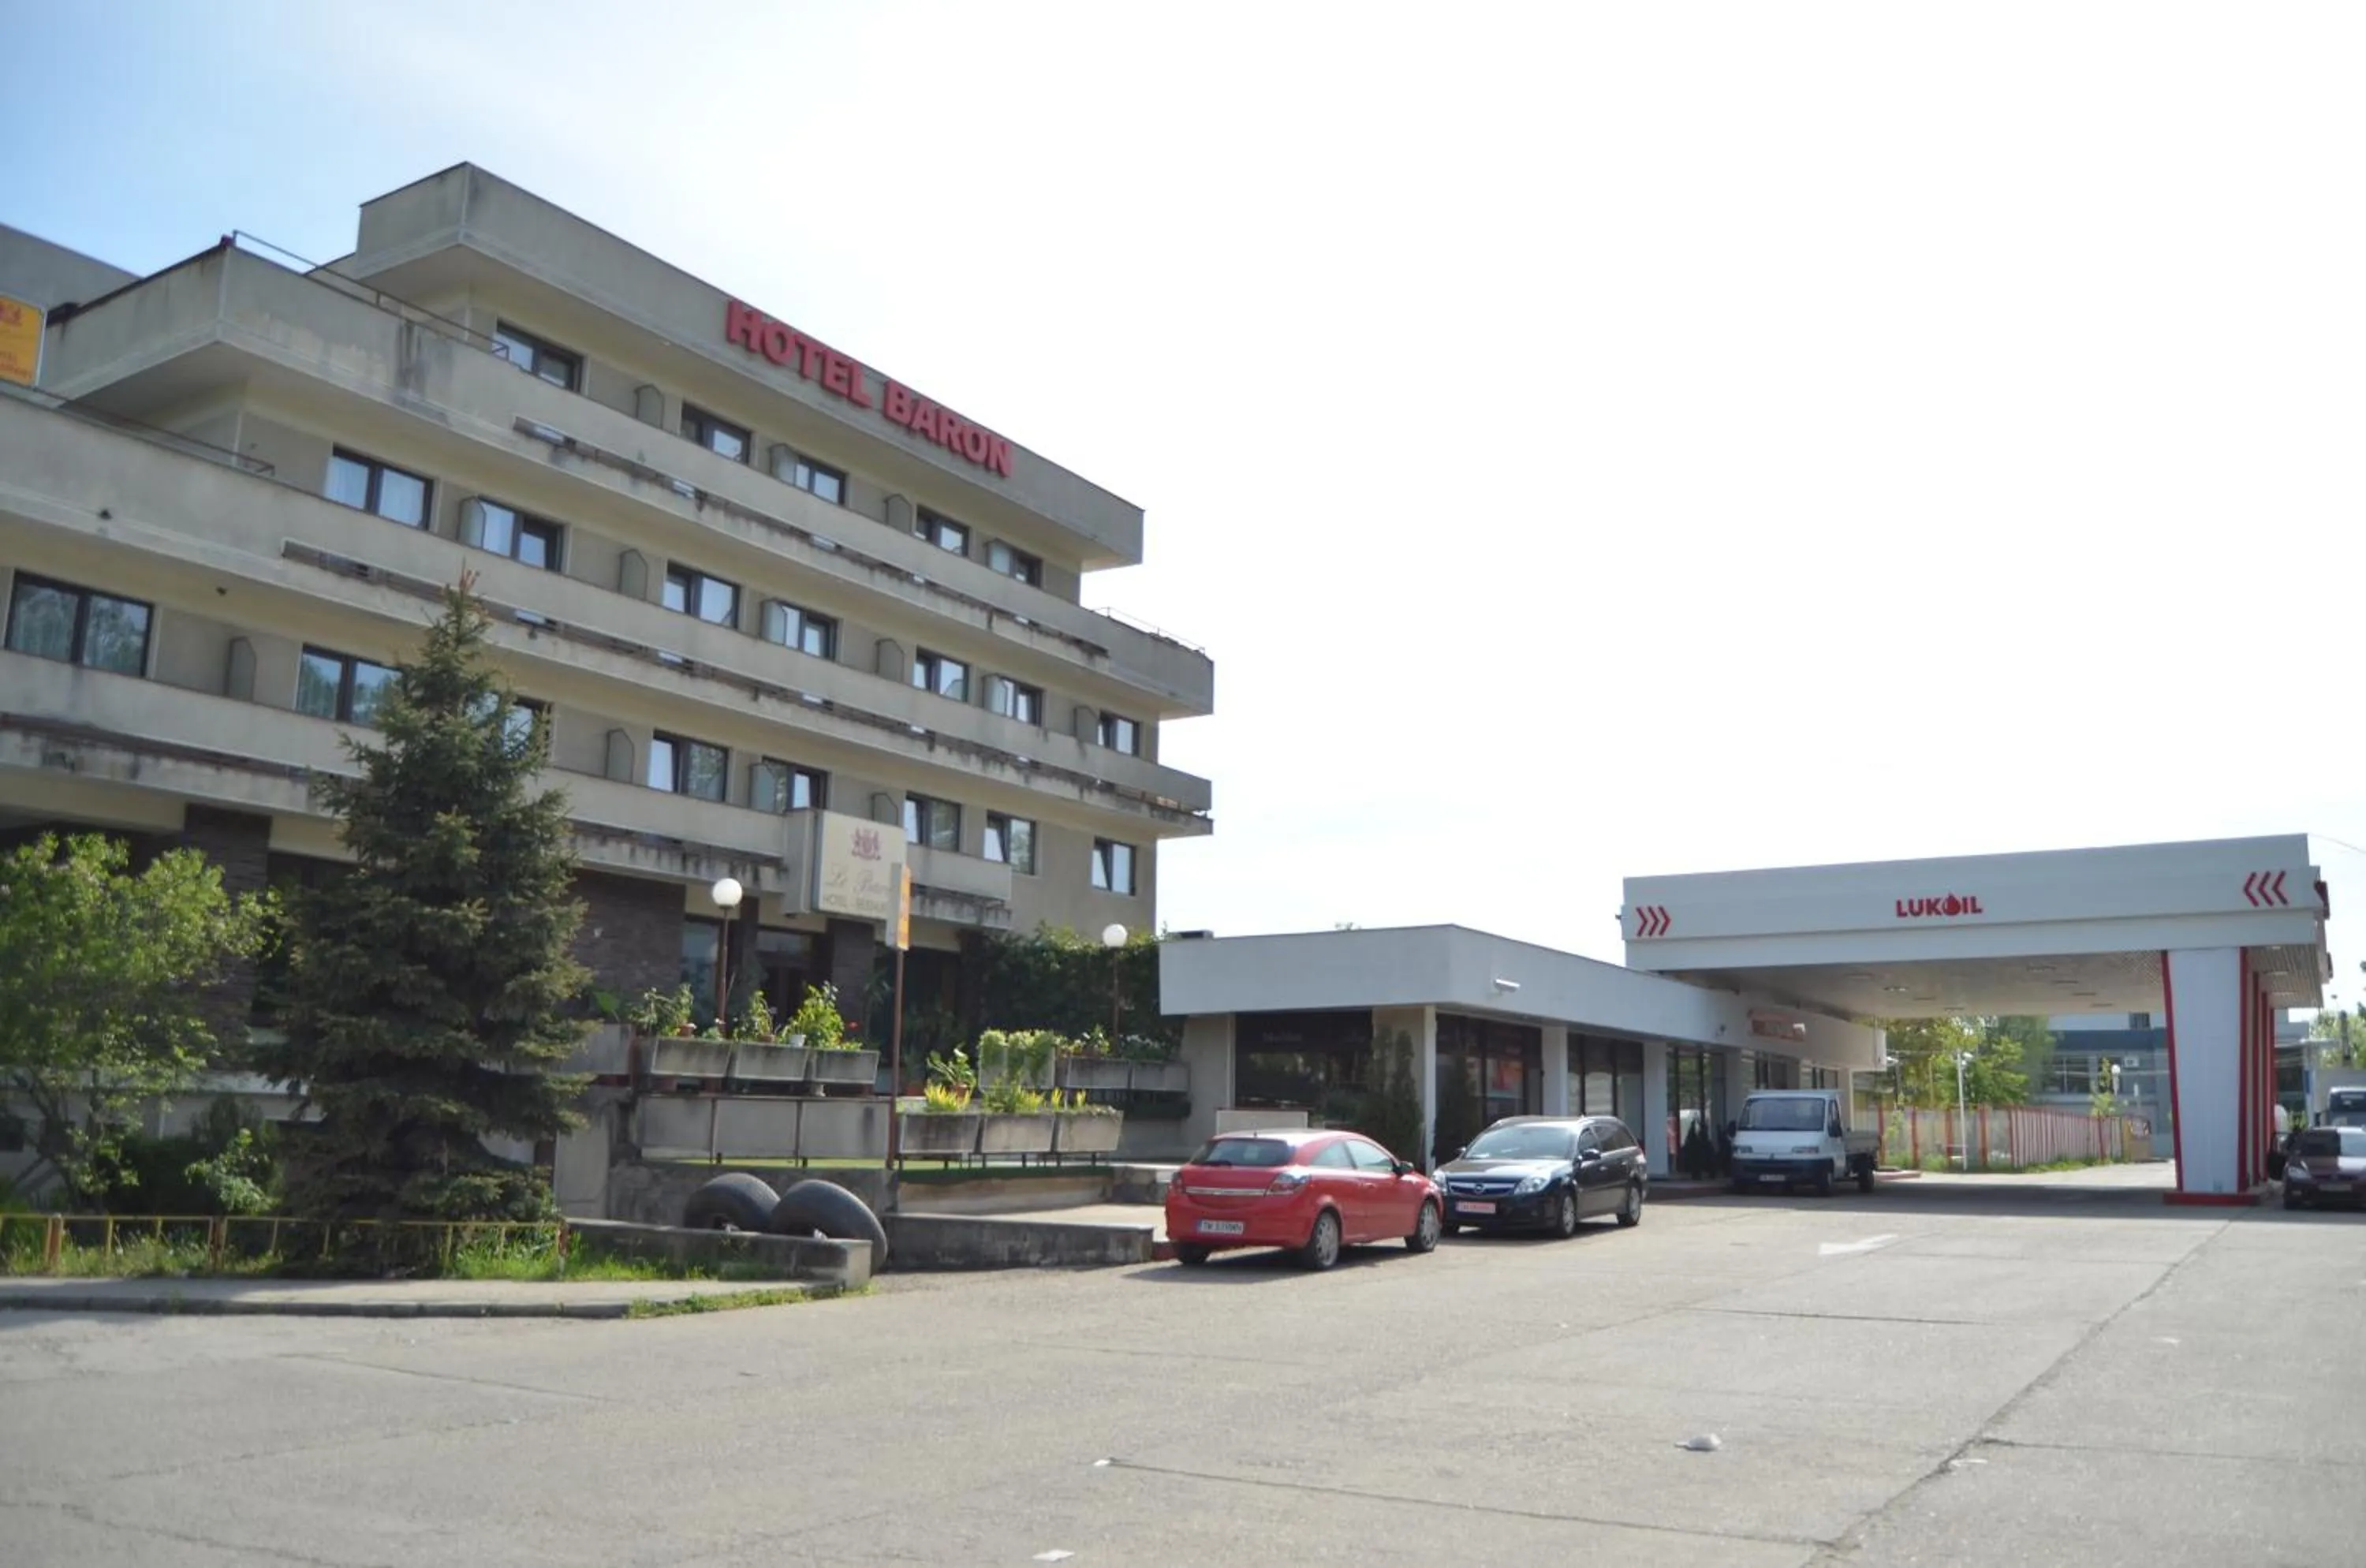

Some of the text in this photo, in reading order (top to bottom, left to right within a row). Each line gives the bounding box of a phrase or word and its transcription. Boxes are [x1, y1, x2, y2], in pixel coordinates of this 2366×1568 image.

[726, 299, 1013, 477] HOTEL BARON
[1896, 891, 1983, 917] LUKOIL
